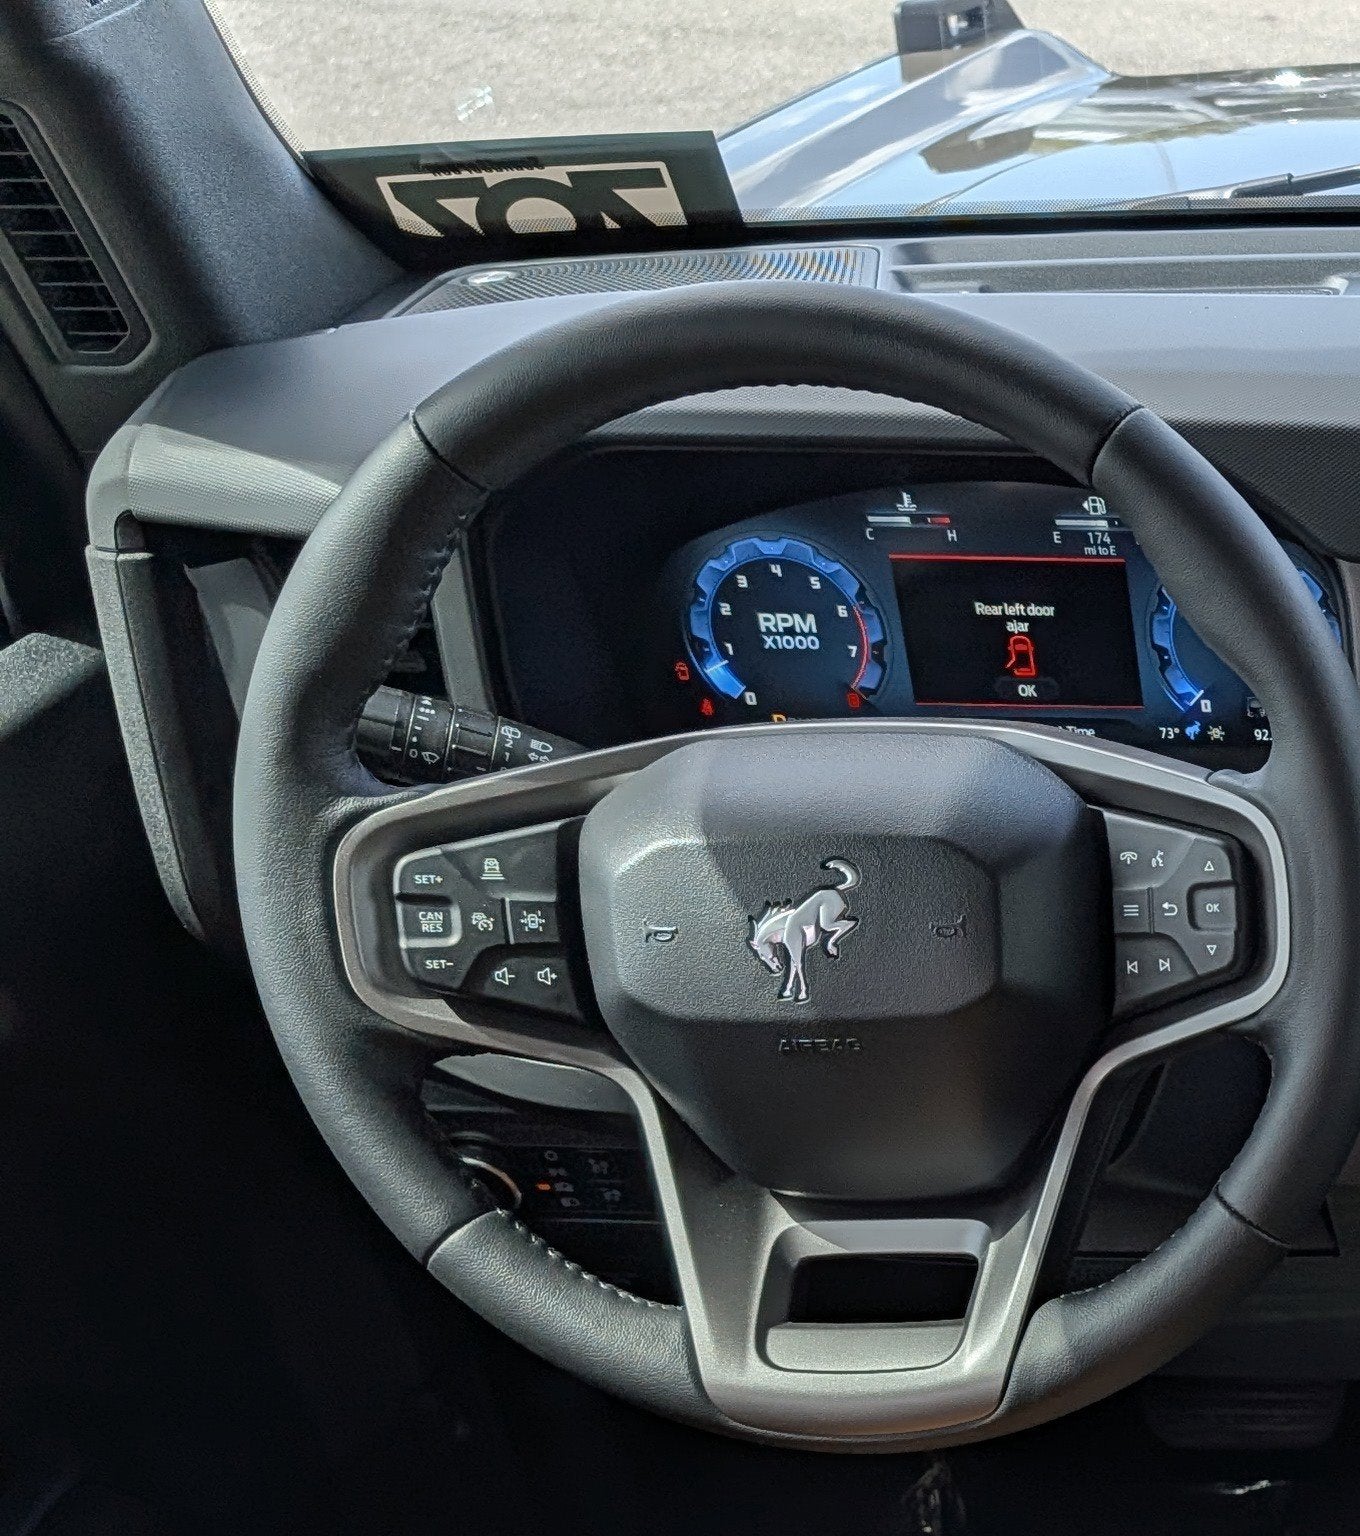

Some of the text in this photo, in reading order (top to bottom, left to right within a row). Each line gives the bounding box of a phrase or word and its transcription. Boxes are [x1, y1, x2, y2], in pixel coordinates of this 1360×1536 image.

[946, 530, 958, 542] H
[1053, 532, 1112, 545] E 174
[768, 563, 782, 578] 4
[735, 574, 749, 589] 3
[808, 576, 822, 590] 5
[718, 602, 732, 616] 2
[836, 604, 850, 618] 6
[974, 601, 1056, 616] Rear left door
[756, 612, 818, 634] RPM
[1005, 619, 1031, 634] ajar
[723, 641, 735, 656] 1
[762, 635, 820, 650] X1000
[847, 644, 858, 658] 7
[1017, 684, 1038, 698] OK
[744, 691, 758, 706] 0
[1200, 698, 1212, 713] 0
[1158, 726, 1180, 739] 73°
[414, 874, 444, 885] SET+
[1206, 902, 1220, 913] OK
[418, 911, 444, 921] CAN
[422, 924, 444, 933] RES
